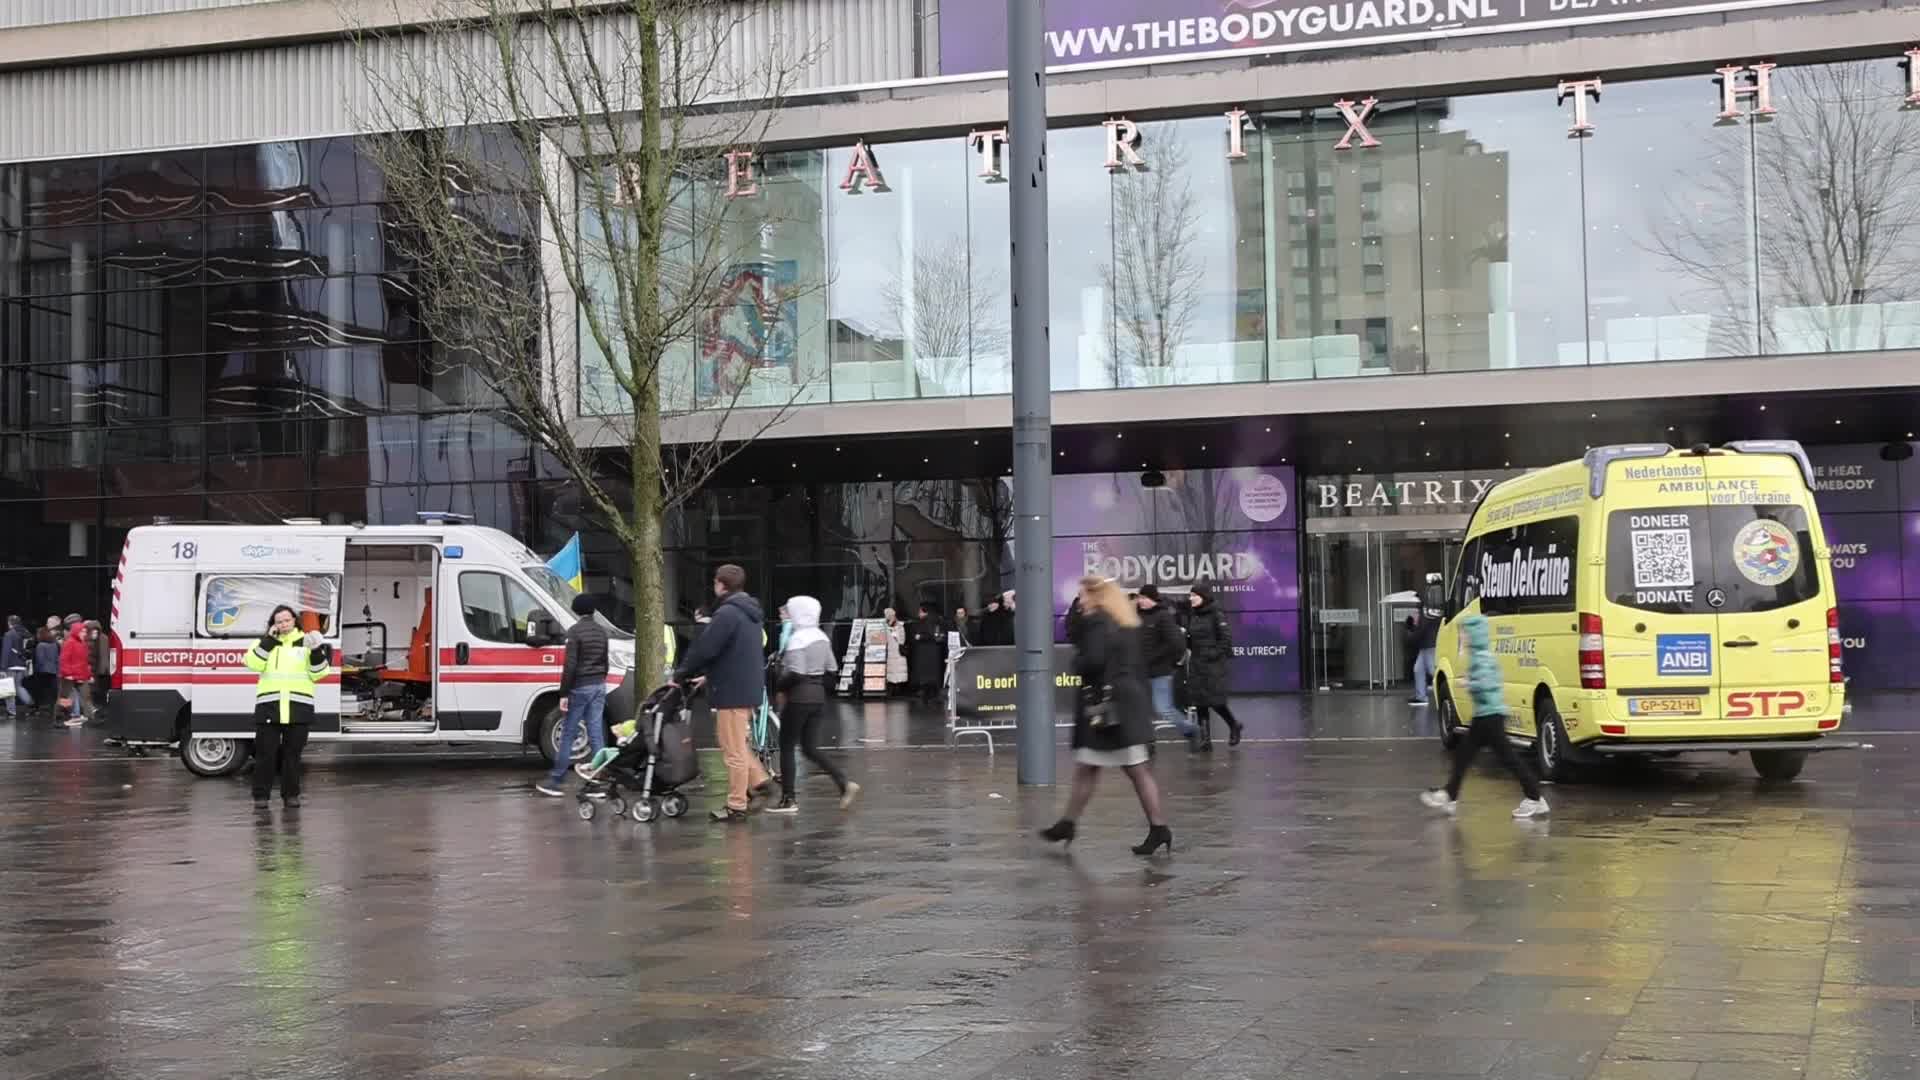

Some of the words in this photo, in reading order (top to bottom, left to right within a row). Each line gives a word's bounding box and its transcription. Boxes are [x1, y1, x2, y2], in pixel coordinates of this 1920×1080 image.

[1045, 0, 1497, 57] WW.THEBODYGUARD.NL
[1625, 463, 1702, 479] Nederlandse
[1828, 465, 1863, 476] HEAT
[1658, 480, 1759, 493] AMBULANCE
[1814, 479, 1874, 491] MEBODY
[1319, 479, 1492, 508] BEATRIX
[1710, 493, 1737, 504] voor
[1631, 514, 1689, 529] DONEER
[1083, 542, 1099, 552] THE
[1083, 552, 1252, 584] BODYGUARD
[1831, 558, 1855, 569] OU
[1480, 544, 1570, 598] SteunOekraïne
[1224, 584, 1256, 592] MUSICAL
[1637, 590, 1694, 604] DONATE
[1840, 637, 1865, 648] OU
[1232, 646, 1245, 656] ER
[1247, 646, 1287, 656] UTRECHT
[1662, 652, 1707, 667] ANBI
[976, 674, 992, 689] De
[1640, 700, 1695, 711] GP-521-H
[1726, 691, 1805, 716] STP
